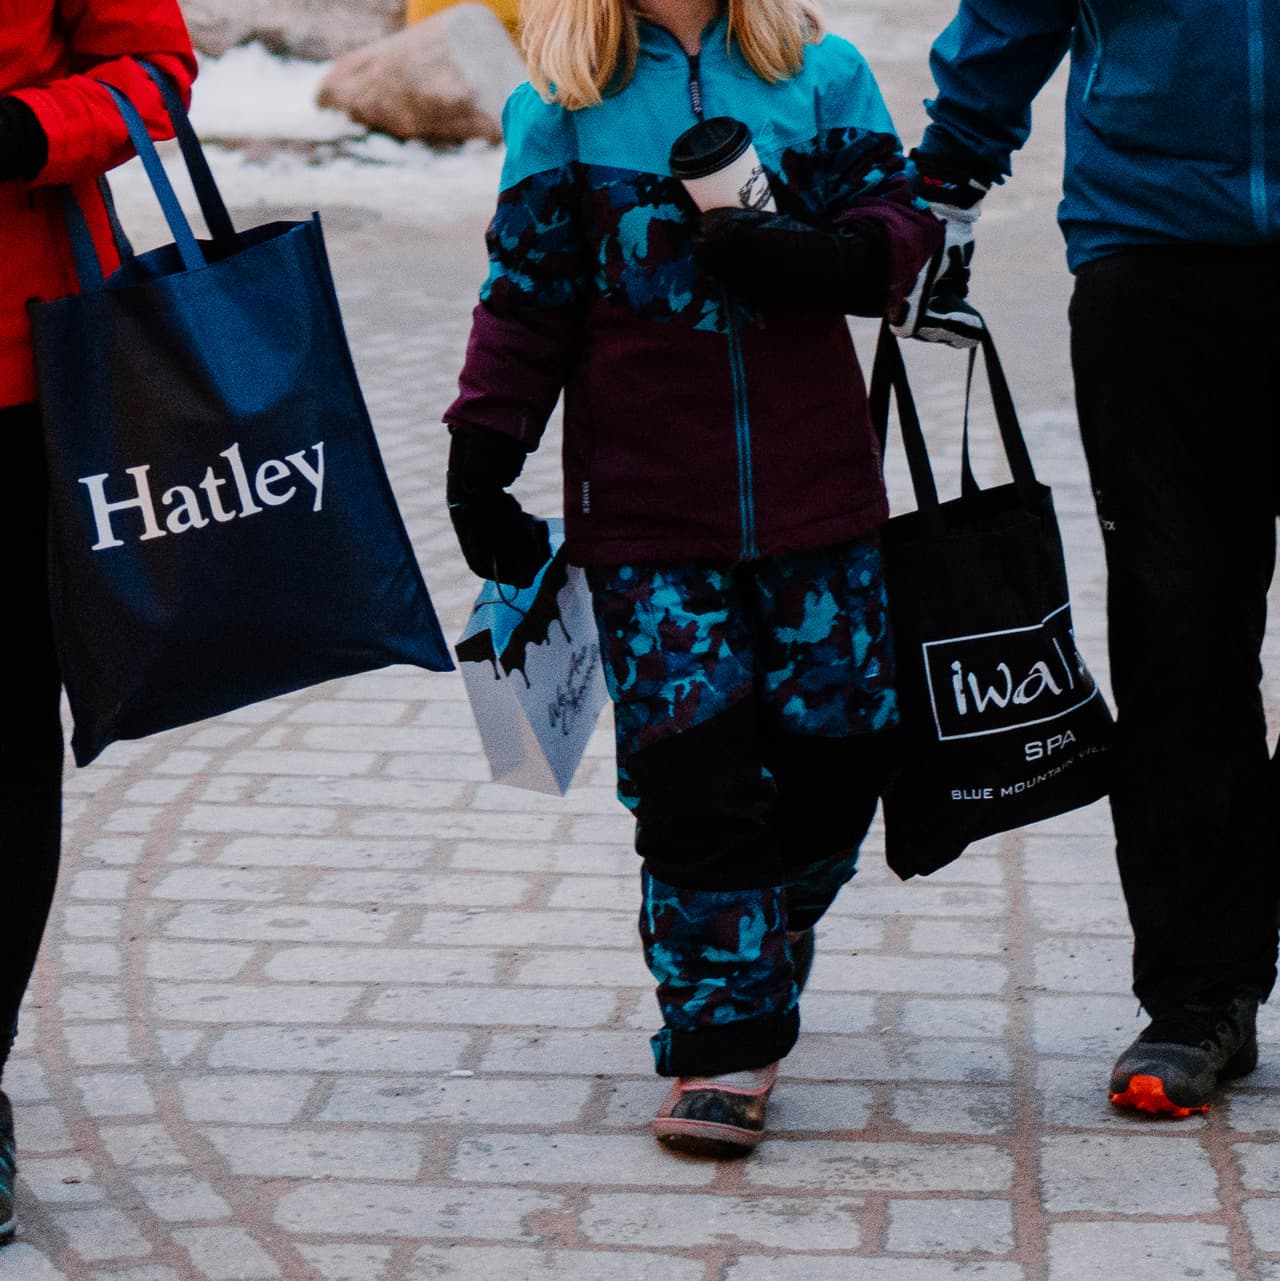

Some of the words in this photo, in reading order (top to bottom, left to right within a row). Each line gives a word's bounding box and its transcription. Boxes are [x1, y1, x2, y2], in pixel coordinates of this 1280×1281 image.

[77, 441, 325, 551] Hatley
[1024, 729, 1077, 762] SPA
[951, 787, 994, 800] BLUE
[1000, 759, 1074, 798] MOUNTAIN
